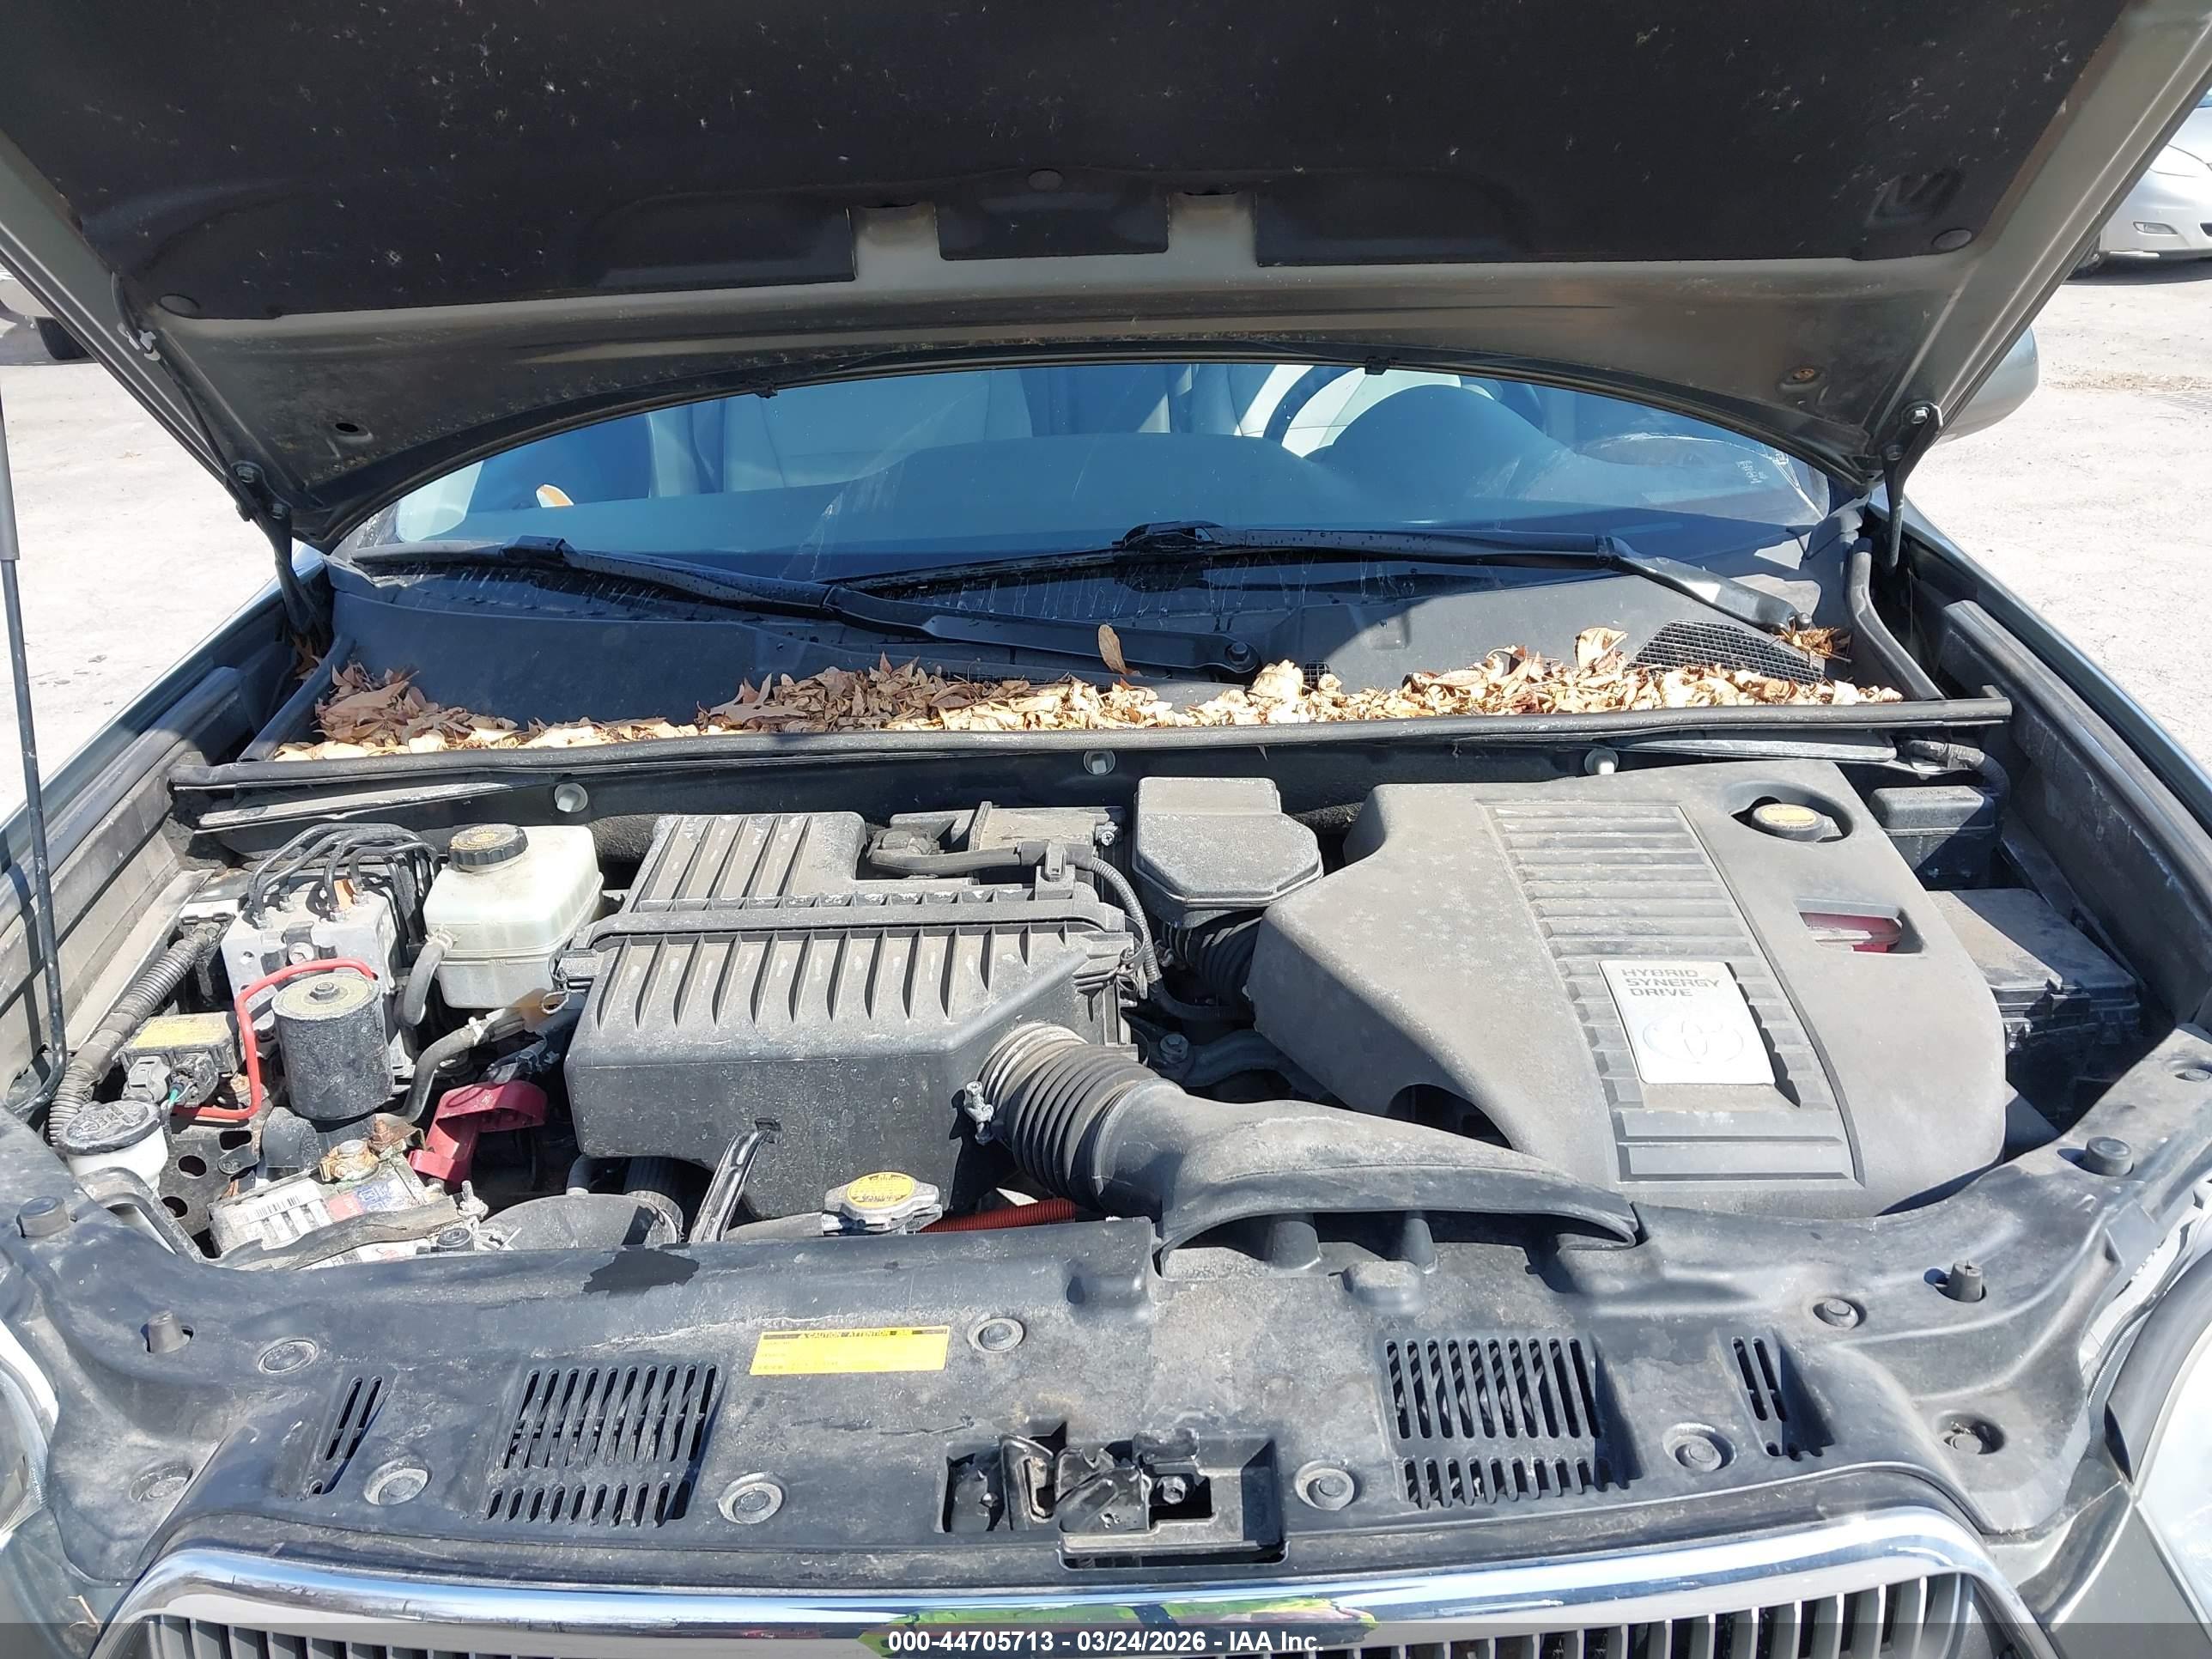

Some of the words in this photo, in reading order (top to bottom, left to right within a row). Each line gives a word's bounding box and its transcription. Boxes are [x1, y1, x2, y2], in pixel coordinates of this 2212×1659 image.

[1620, 968, 1698, 978] HYBRID
[1625, 977, 1720, 988] SYNERGY
[1631, 988, 1693, 997] DRIVE
